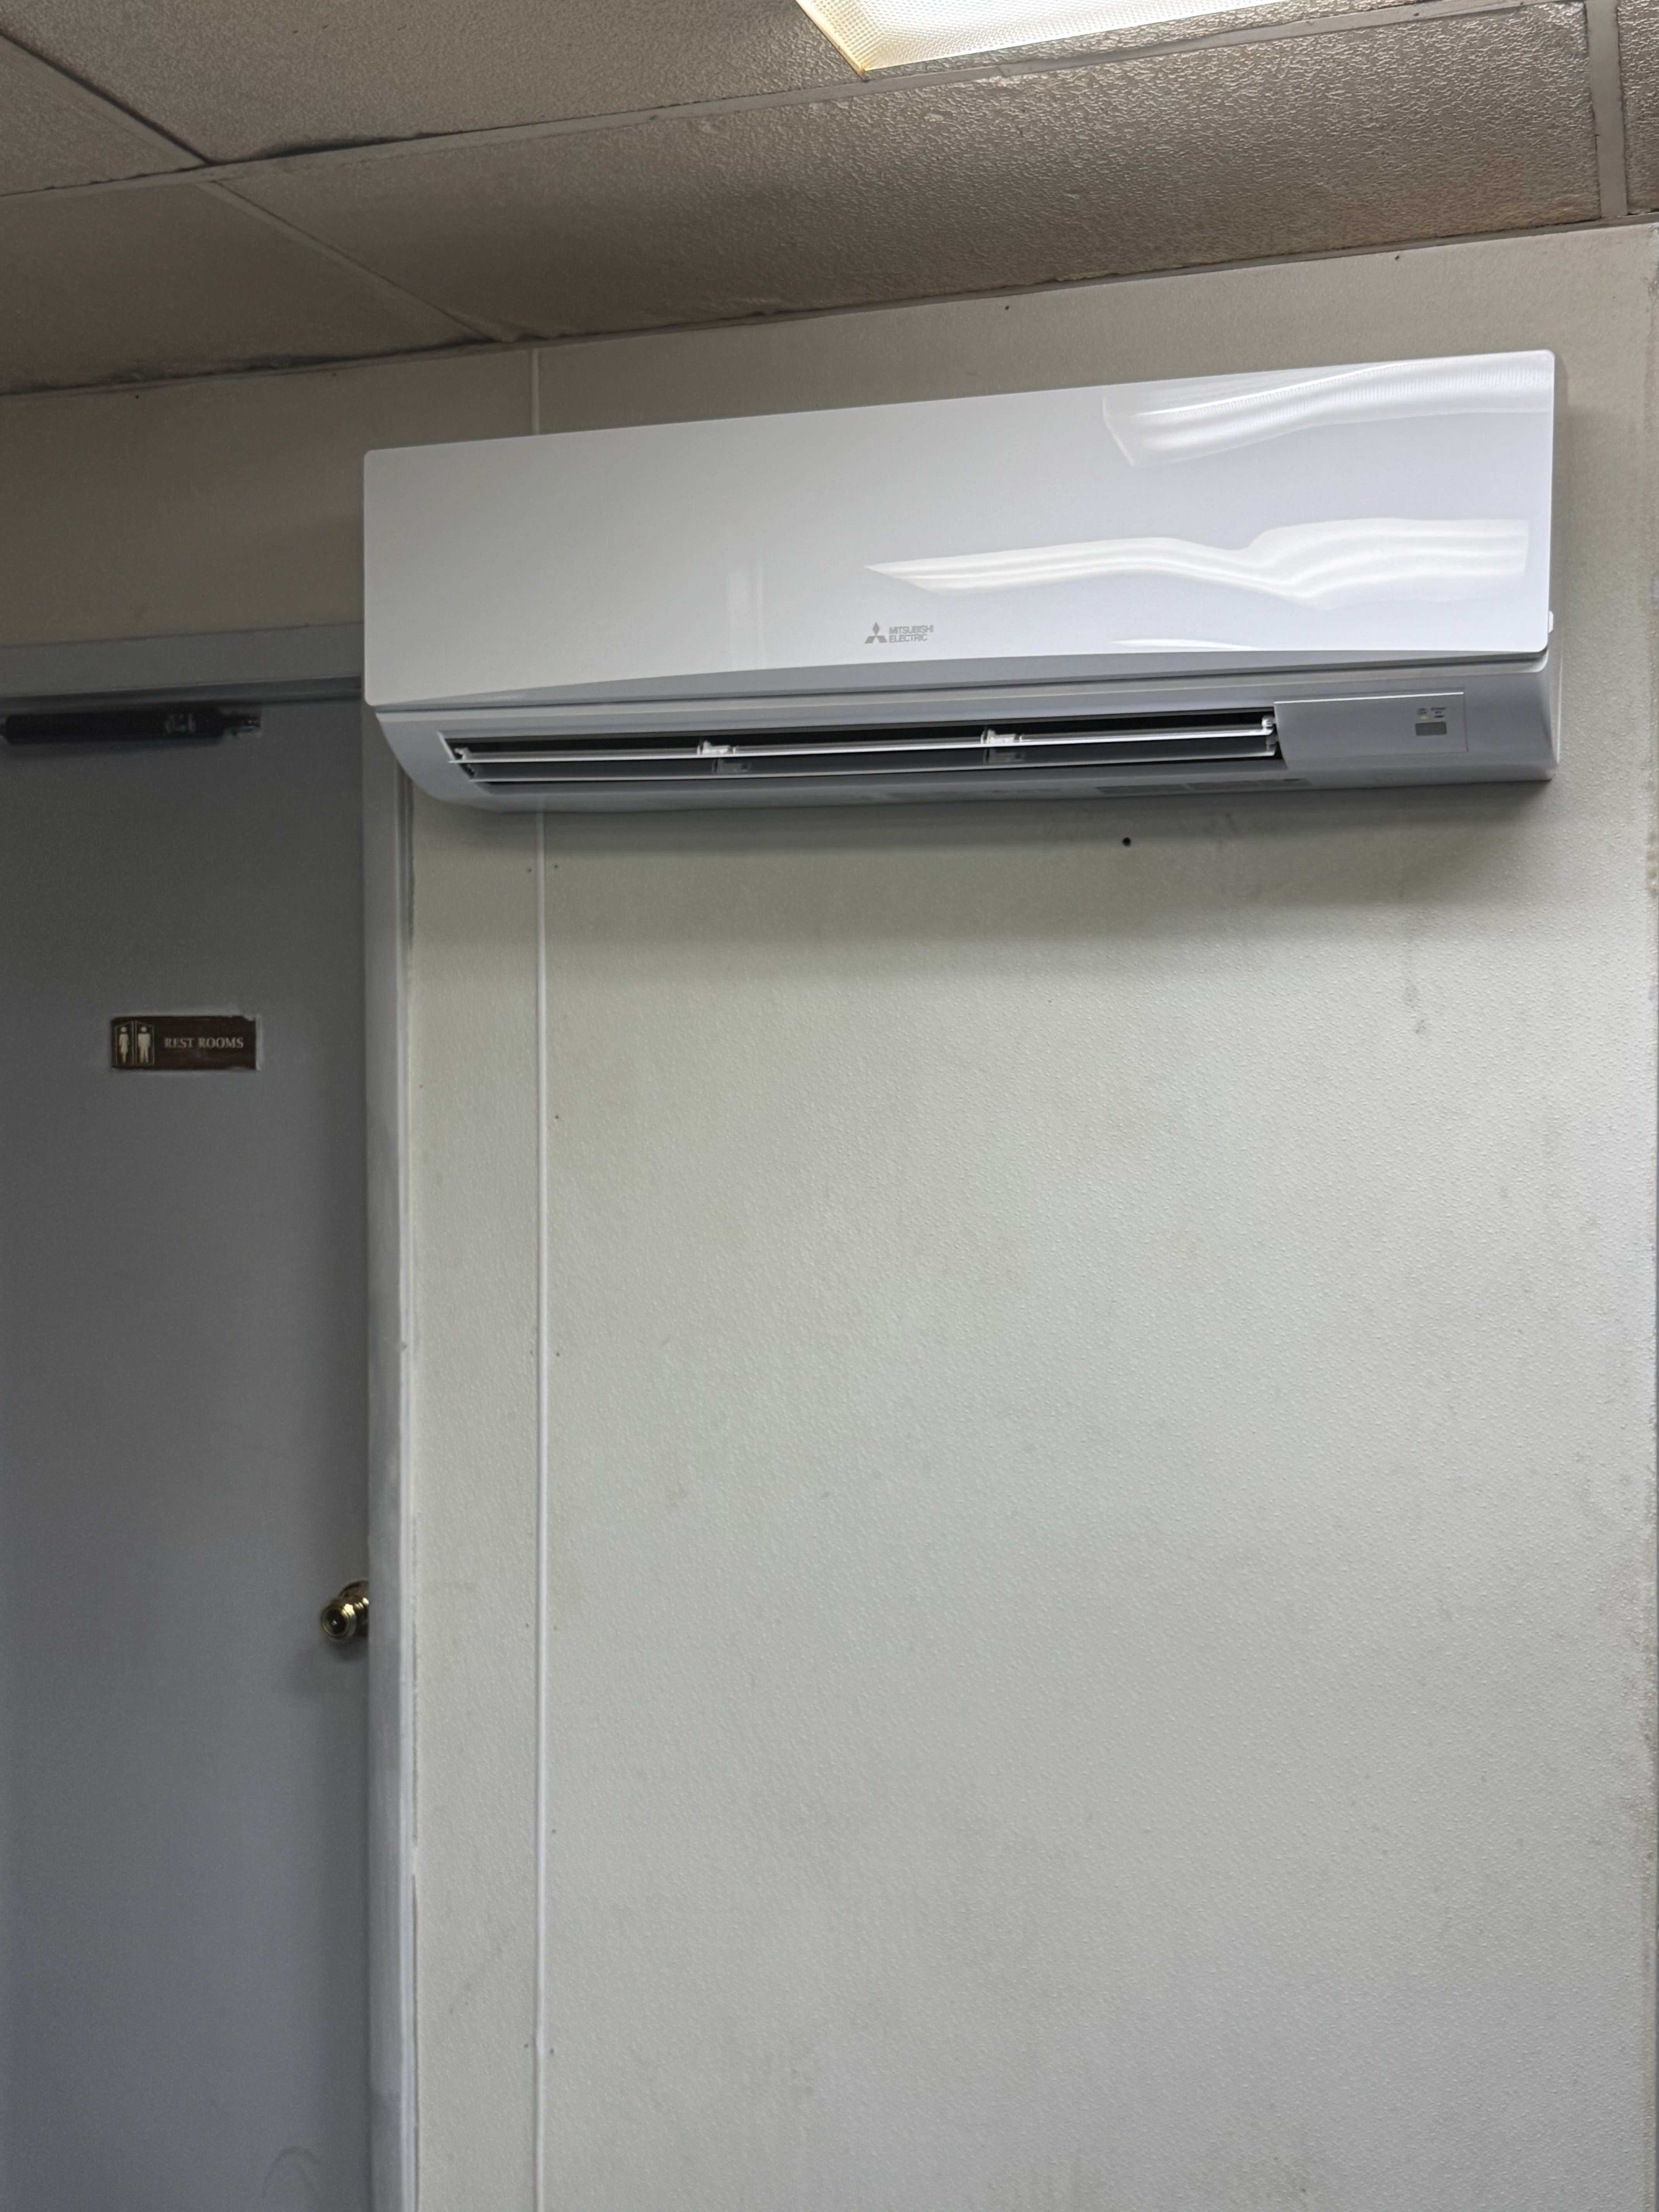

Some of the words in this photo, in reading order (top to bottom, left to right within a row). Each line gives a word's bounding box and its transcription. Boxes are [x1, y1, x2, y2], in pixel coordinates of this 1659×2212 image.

[889, 625, 934, 634] MITSUBISHI
[889, 634, 928, 643] ELECTRIC
[164, 1037, 194, 1048] REST
[198, 1037, 244, 1049] ROOMS
